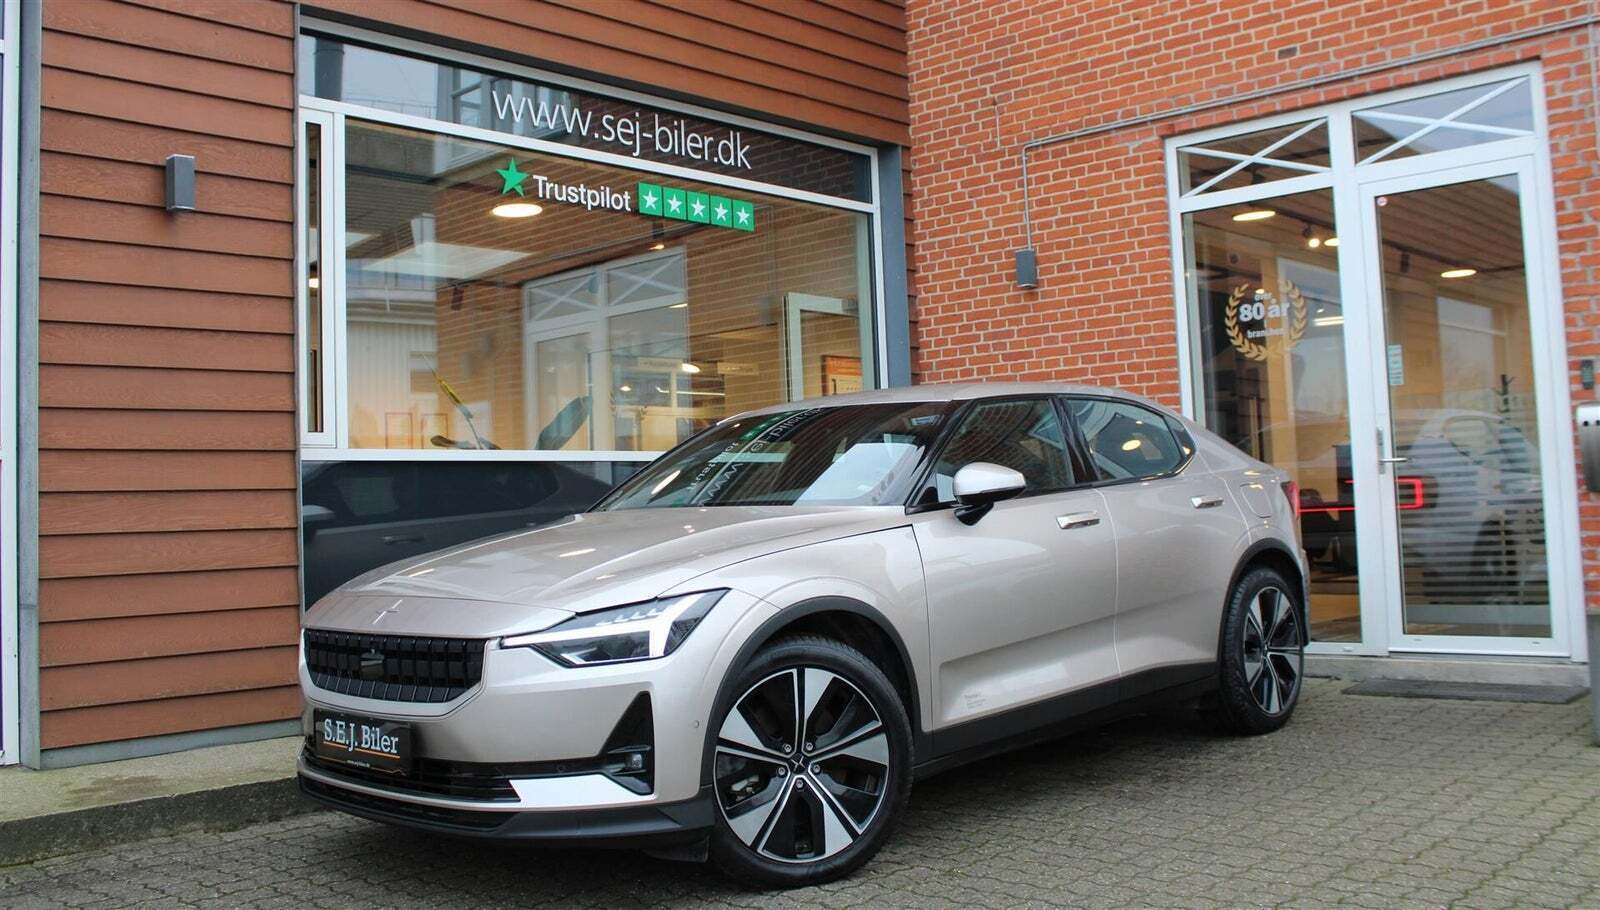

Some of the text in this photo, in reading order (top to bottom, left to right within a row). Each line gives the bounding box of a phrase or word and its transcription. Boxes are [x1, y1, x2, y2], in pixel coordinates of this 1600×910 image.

[492, 90, 752, 170] www.sej-biler.dk
[532, 174, 631, 212] Trustpilot
[1240, 299, 1290, 321] 80 år
[1247, 327, 1287, 338] bran
[324, 718, 399, 753] S.E.J. Biler
